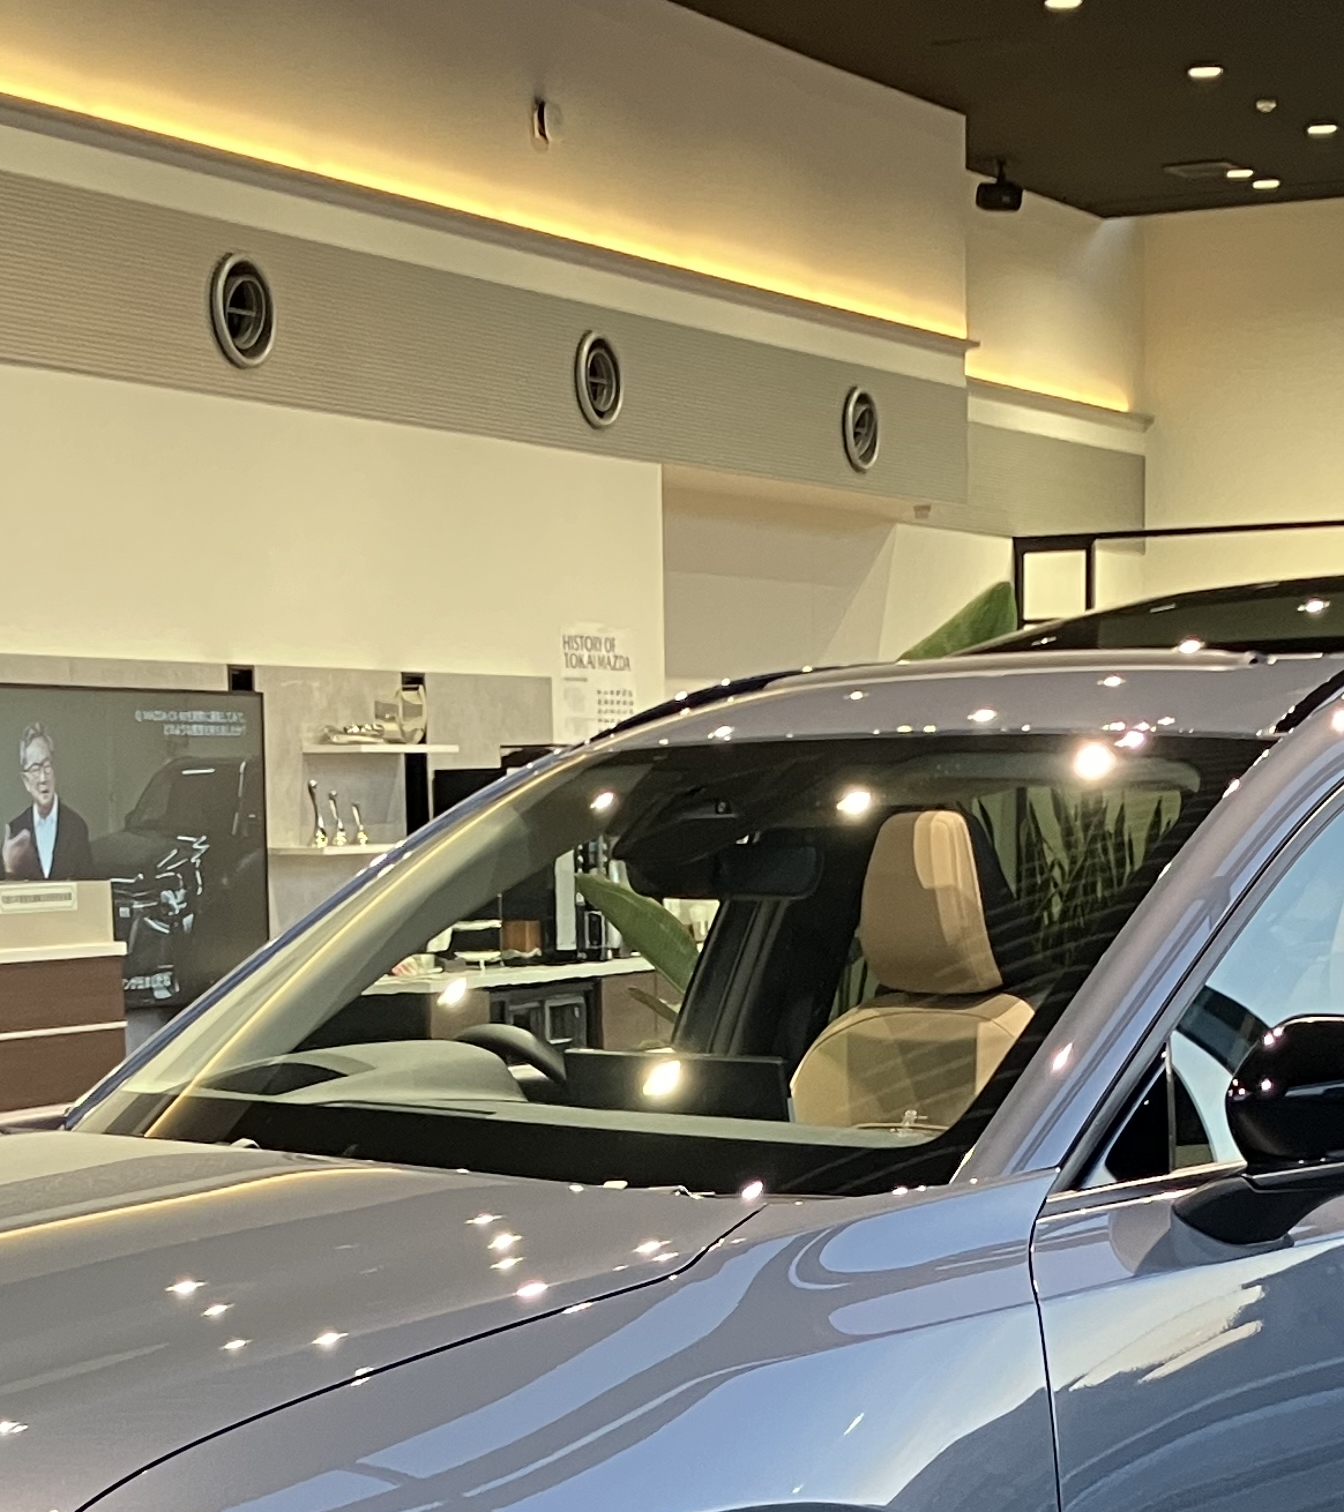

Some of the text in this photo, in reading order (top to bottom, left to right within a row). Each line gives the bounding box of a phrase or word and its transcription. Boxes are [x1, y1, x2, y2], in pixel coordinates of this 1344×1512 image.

[562, 634, 616, 653] HISTORY OF
[597, 653, 631, 671] MAZDA
